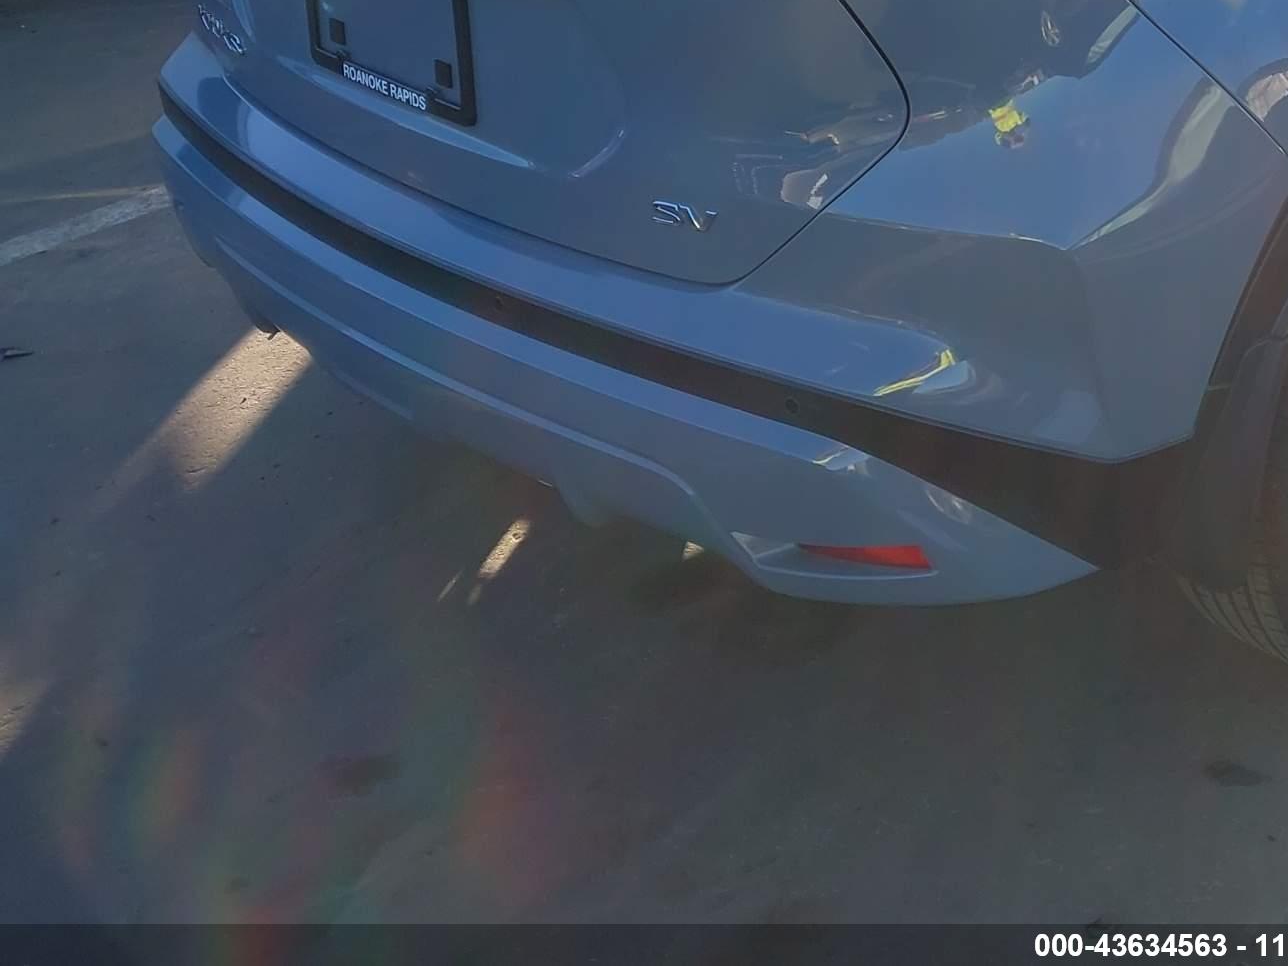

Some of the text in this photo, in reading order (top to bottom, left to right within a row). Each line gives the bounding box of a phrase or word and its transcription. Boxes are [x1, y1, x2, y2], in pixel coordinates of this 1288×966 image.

[343, 64, 427, 110] ROANOKE RAPIDS
[653, 201, 718, 231] SV
